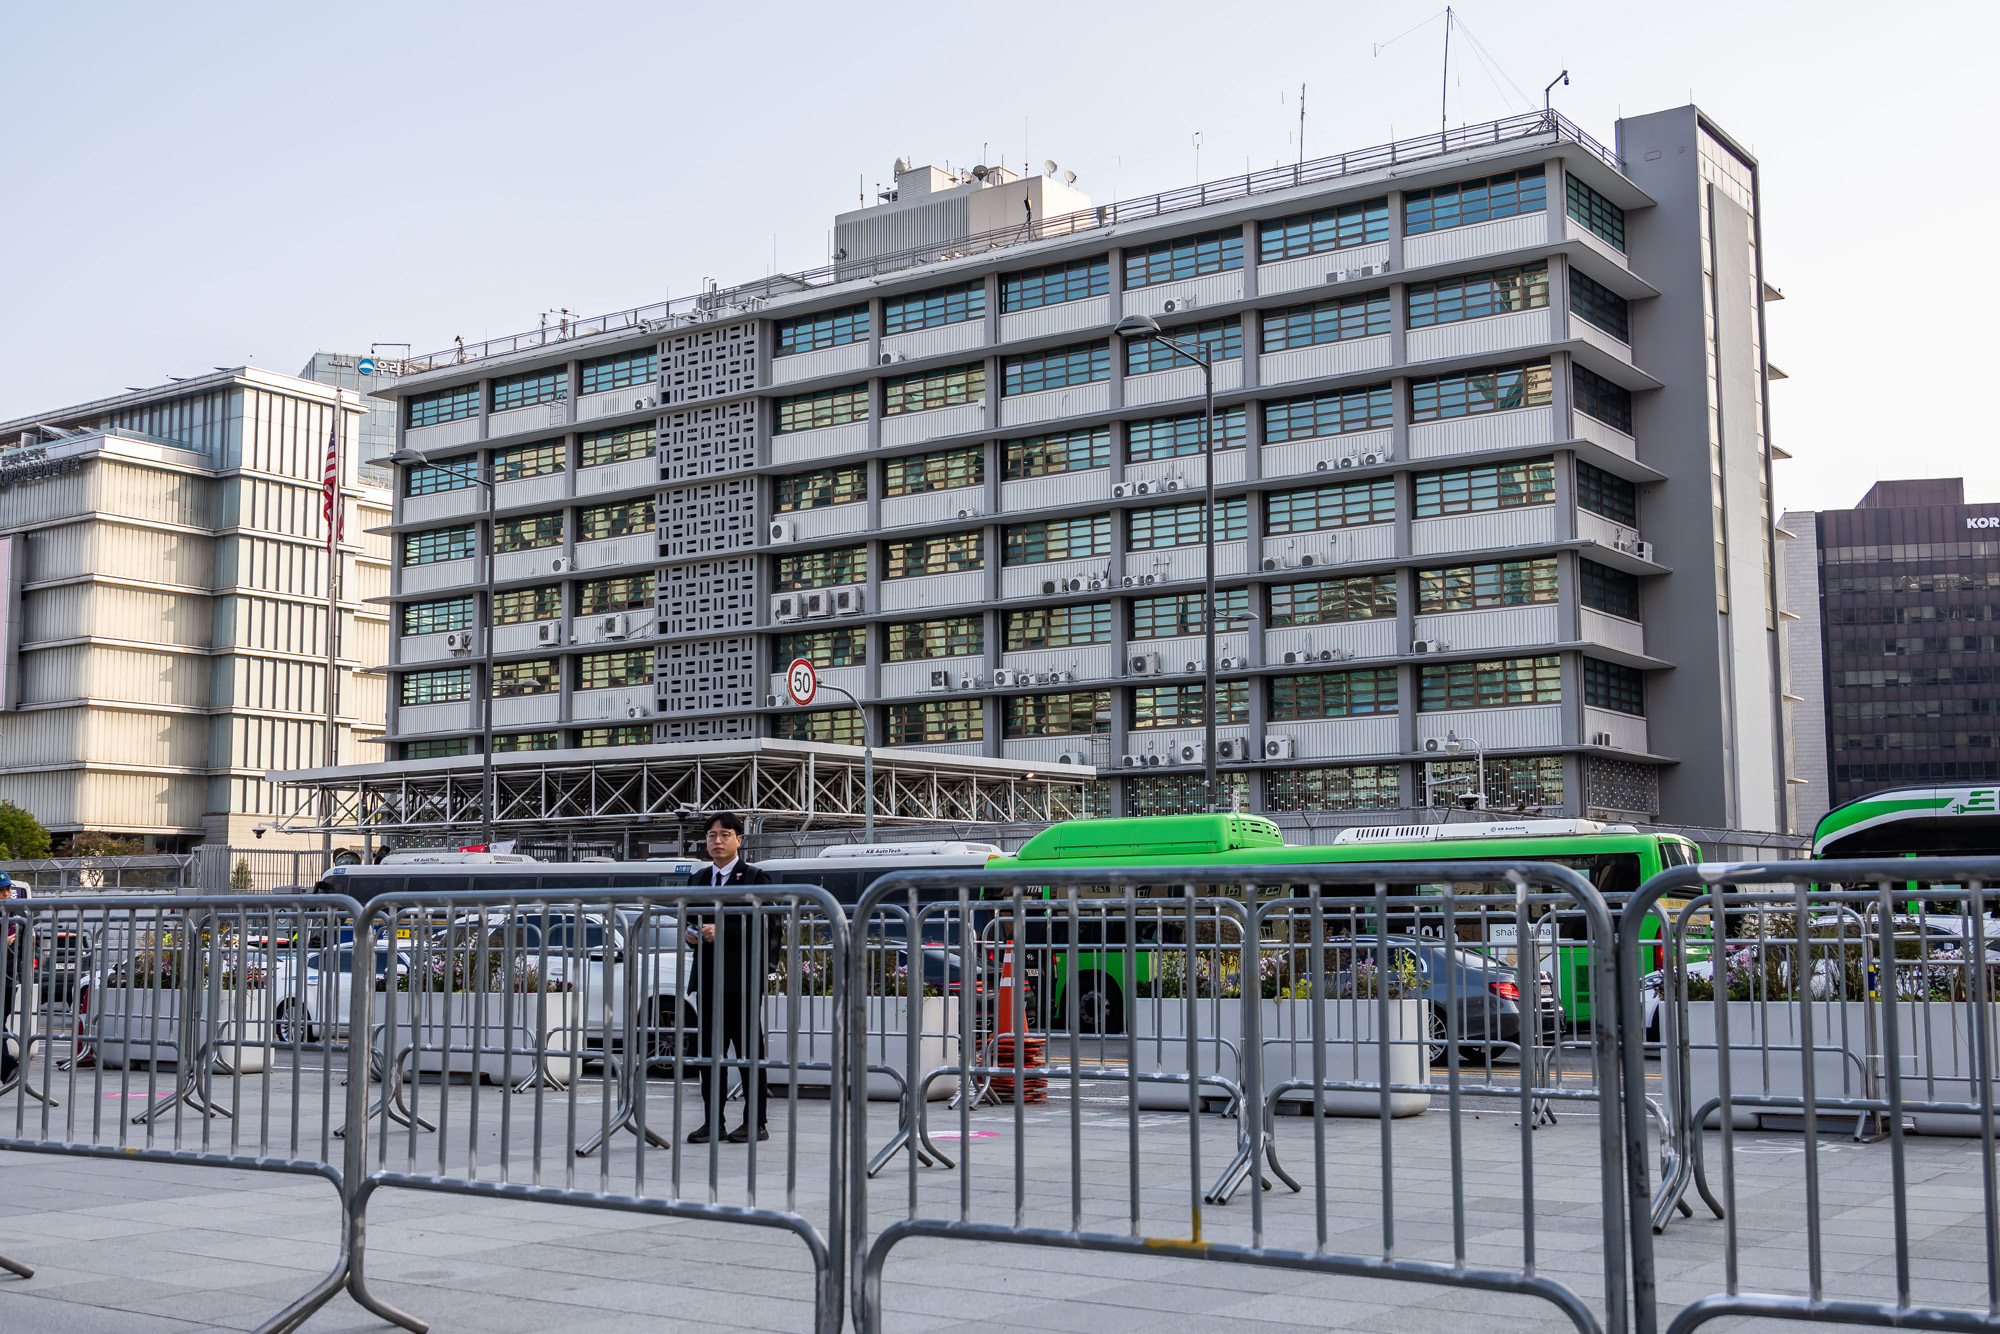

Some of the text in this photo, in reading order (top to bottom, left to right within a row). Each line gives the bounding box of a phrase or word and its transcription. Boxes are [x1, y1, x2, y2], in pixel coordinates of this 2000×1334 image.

[375, 361, 401, 377] 우리
[794, 671, 811, 694] 50
[1026, 885, 1043, 893] 7778
